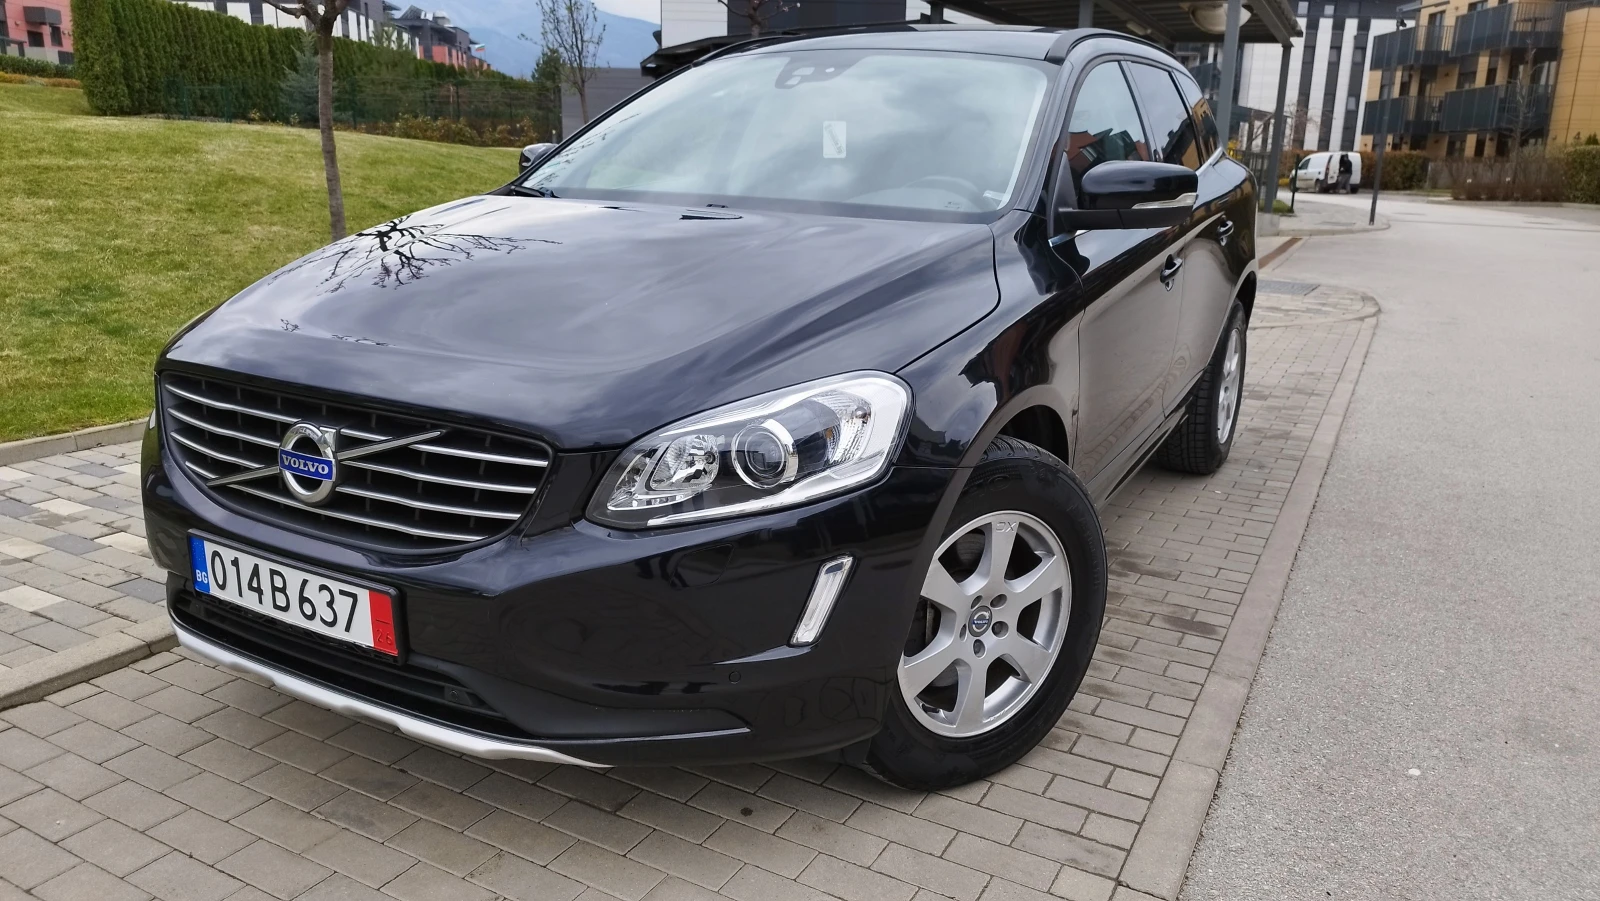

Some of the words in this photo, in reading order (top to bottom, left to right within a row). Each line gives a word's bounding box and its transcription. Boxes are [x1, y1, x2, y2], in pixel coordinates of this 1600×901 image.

[281, 454, 329, 475] VOLVO
[195, 569, 208, 584] BG
[211, 550, 358, 633] 014B637
[376, 629, 393, 646] 26
